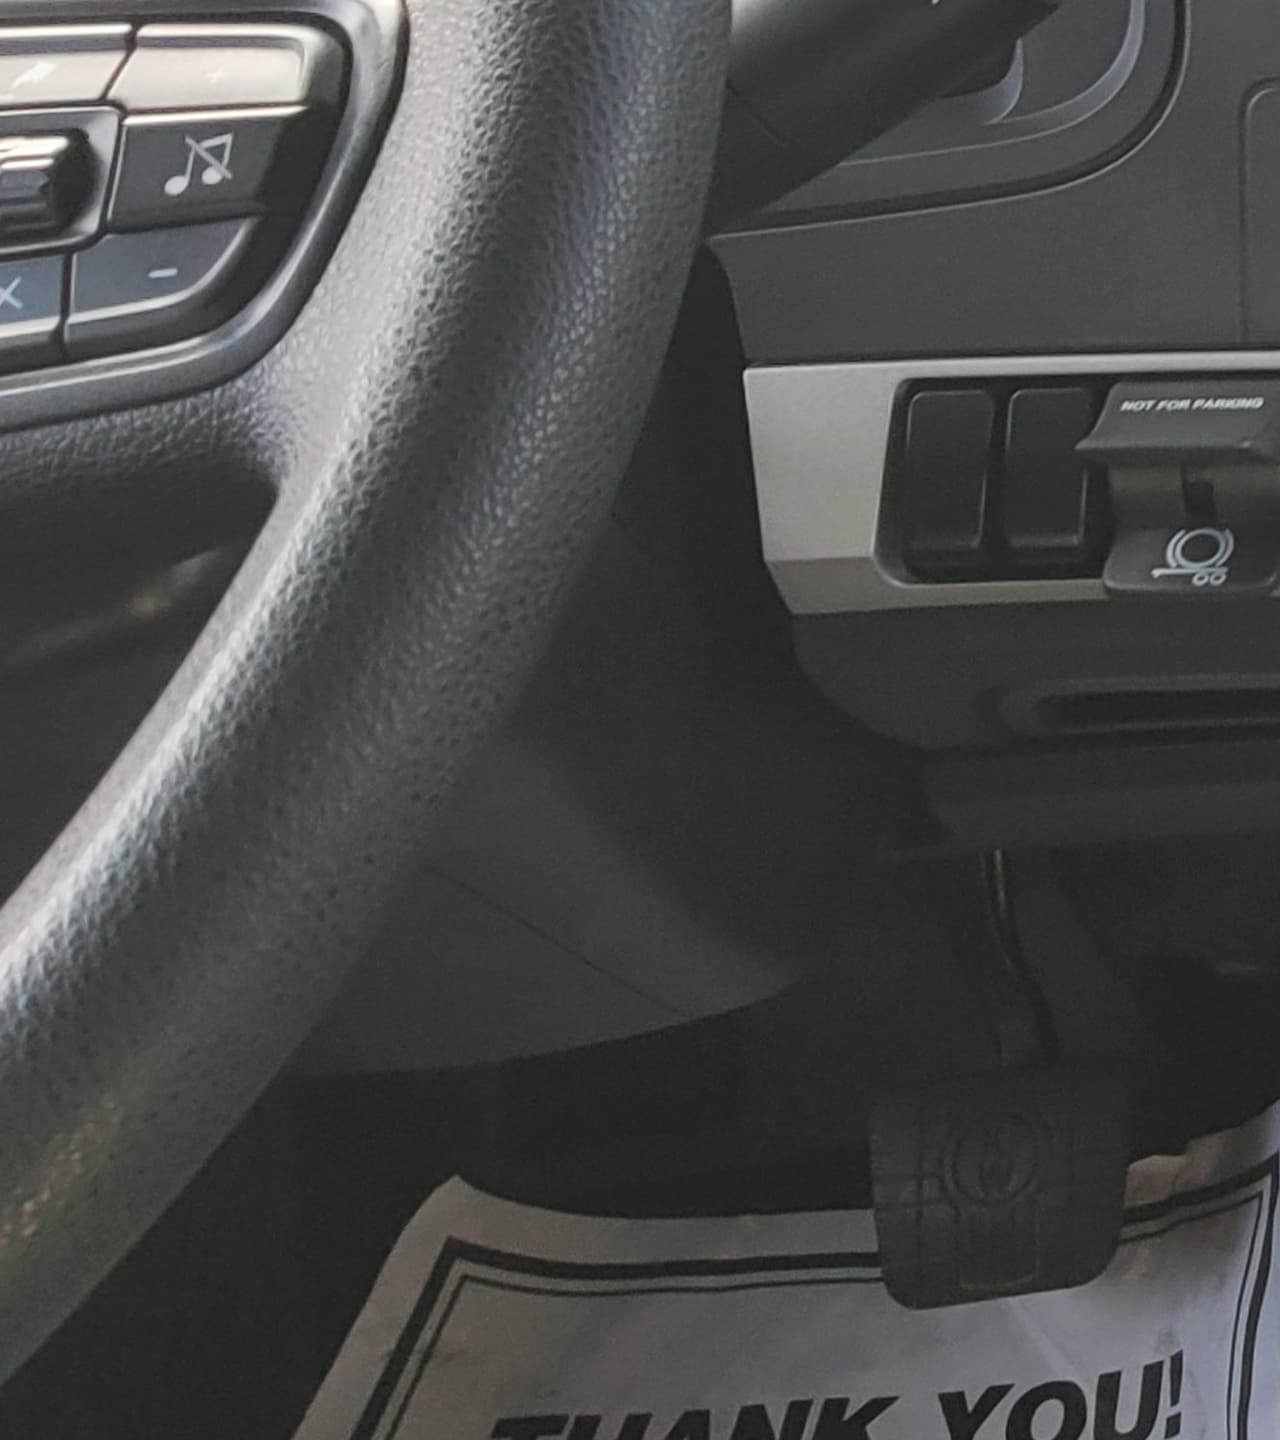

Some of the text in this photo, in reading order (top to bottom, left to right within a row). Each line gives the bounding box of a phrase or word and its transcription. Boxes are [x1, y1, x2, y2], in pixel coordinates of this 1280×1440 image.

[1120, 396, 1264, 411] NOT FOR PARKING
[937, 1349, 1184, 1440] YOU!
